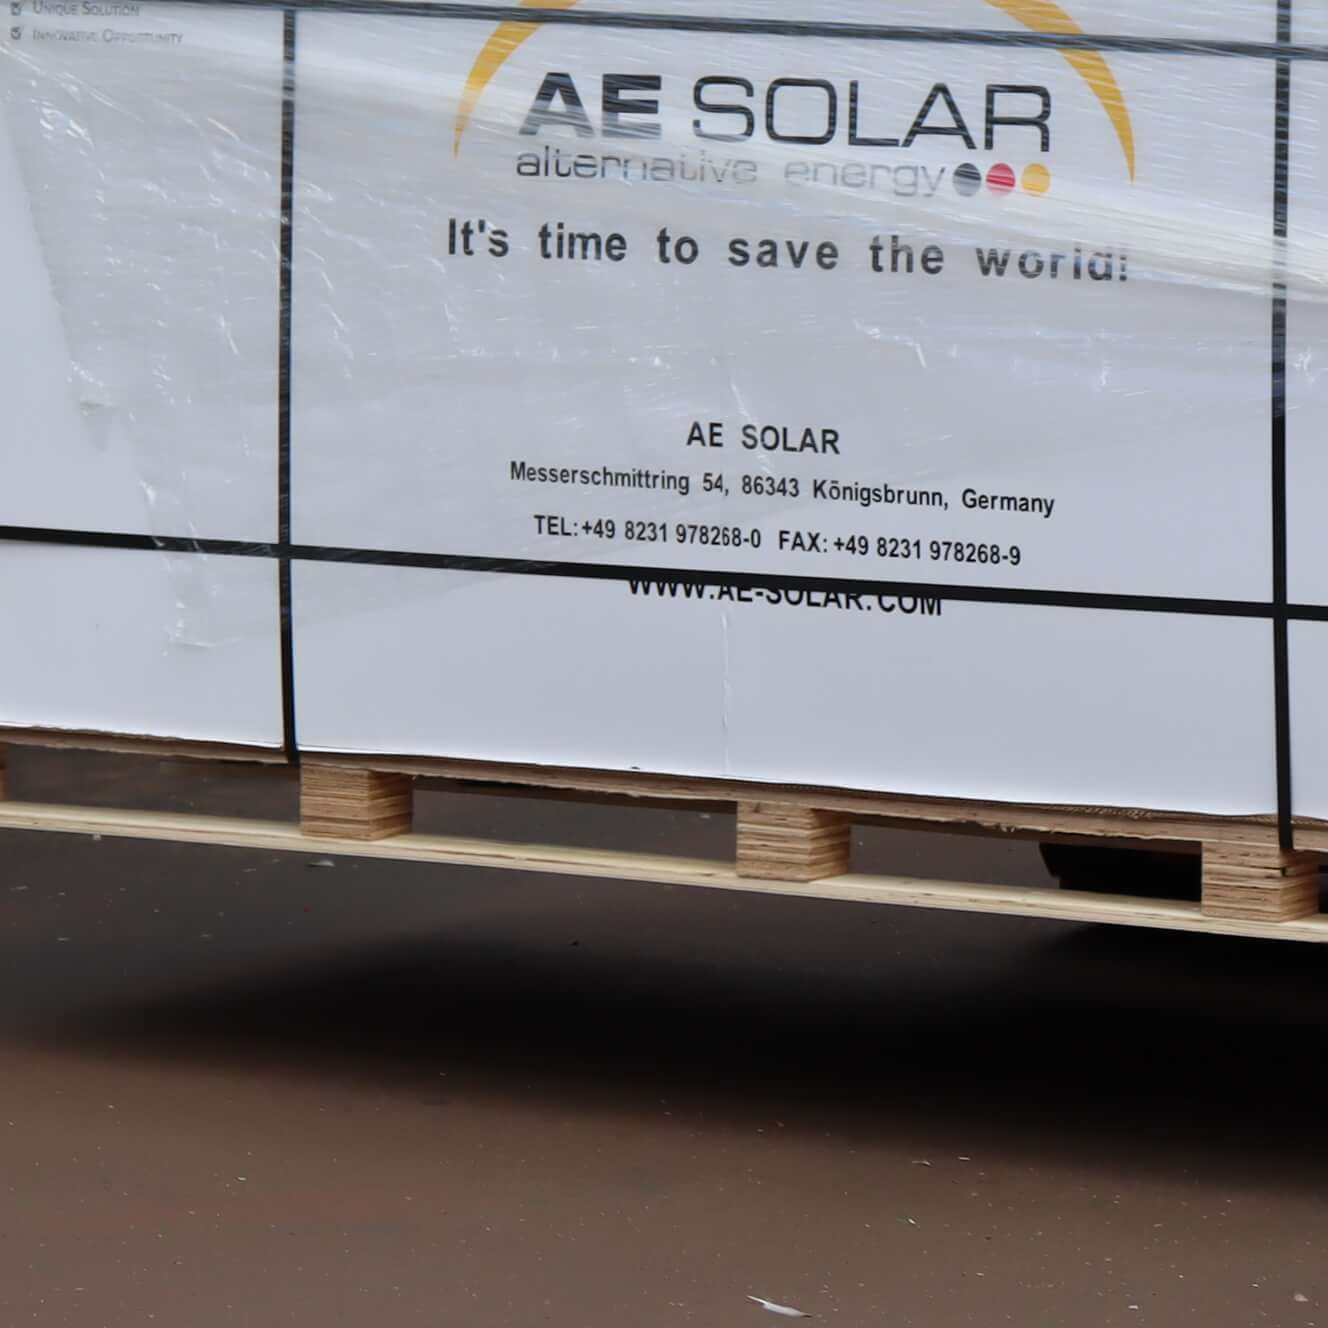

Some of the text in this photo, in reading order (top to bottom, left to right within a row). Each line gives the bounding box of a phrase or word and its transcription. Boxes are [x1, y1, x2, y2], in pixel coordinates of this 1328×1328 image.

[518, 72, 1053, 154] AE SOLAR
[516, 145, 946, 198] alternative energy
[448, 218, 1129, 282] It's time to save the world!
[686, 421, 840, 455] AE SOLAR
[510, 461, 690, 495] Messerschmittring
[702, 472, 730, 497] 54,
[741, 475, 800, 499] 86343
[961, 487, 1055, 519] Germany
[624, 520, 667, 542] 8231
[675, 523, 762, 549] 978268-0
[876, 537, 922, 560] 8231
[929, 540, 1022, 566] 978268-9
